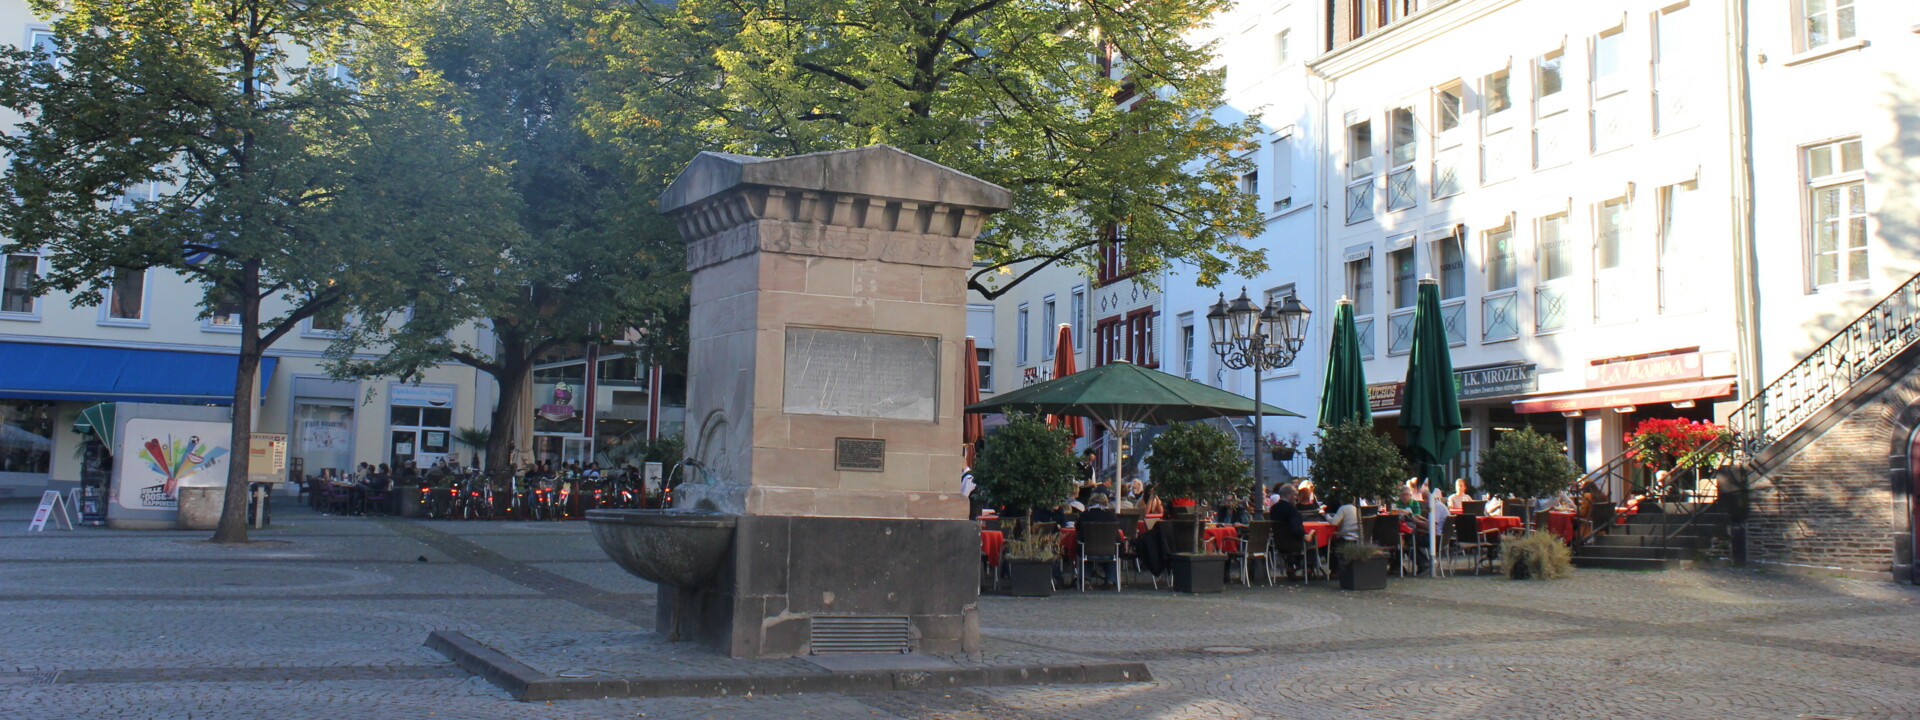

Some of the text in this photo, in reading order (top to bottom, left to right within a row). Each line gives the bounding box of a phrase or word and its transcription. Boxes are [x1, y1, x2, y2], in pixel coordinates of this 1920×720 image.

[1464, 373, 1480, 387] I.K.
[1482, 367, 1527, 385] MROZEK
[145, 492, 167, 501] DOSE
